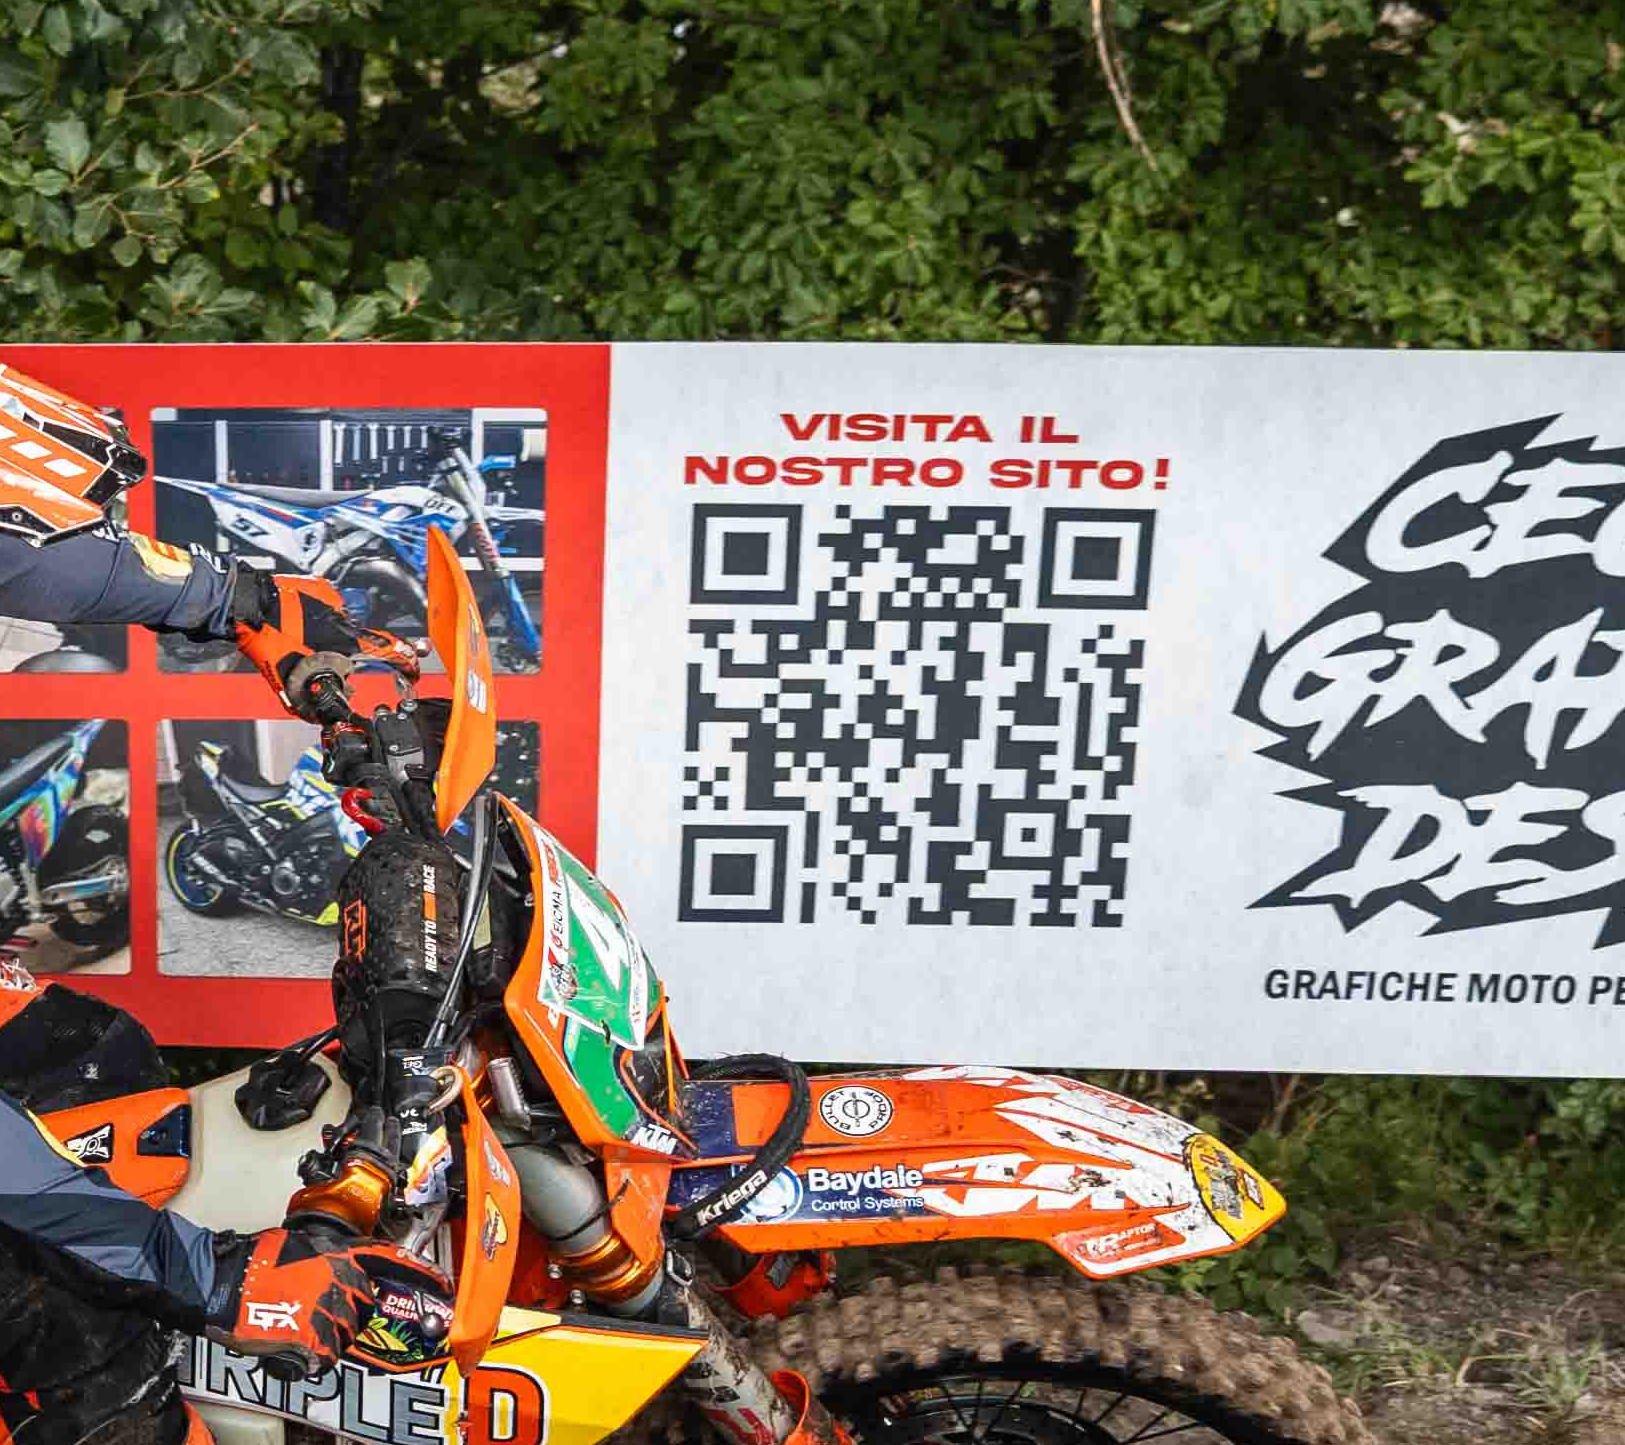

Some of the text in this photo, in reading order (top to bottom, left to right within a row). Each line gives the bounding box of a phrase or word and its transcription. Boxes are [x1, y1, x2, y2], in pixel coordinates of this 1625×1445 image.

[779, 412, 1079, 444] VISITA IL
[682, 456, 1172, 490] NOSTRO SITO!
[423, 865, 438, 972] READY TO RACE
[1263, 967, 1459, 1004] GRAFICHE
[1465, 971, 1578, 1006] MOTO
[631, 1123, 677, 1155] KTM
[808, 1166, 923, 1192] Baydale
[698, 1168, 768, 1226] Kriega
[811, 1196, 924, 1212] Control Systems
